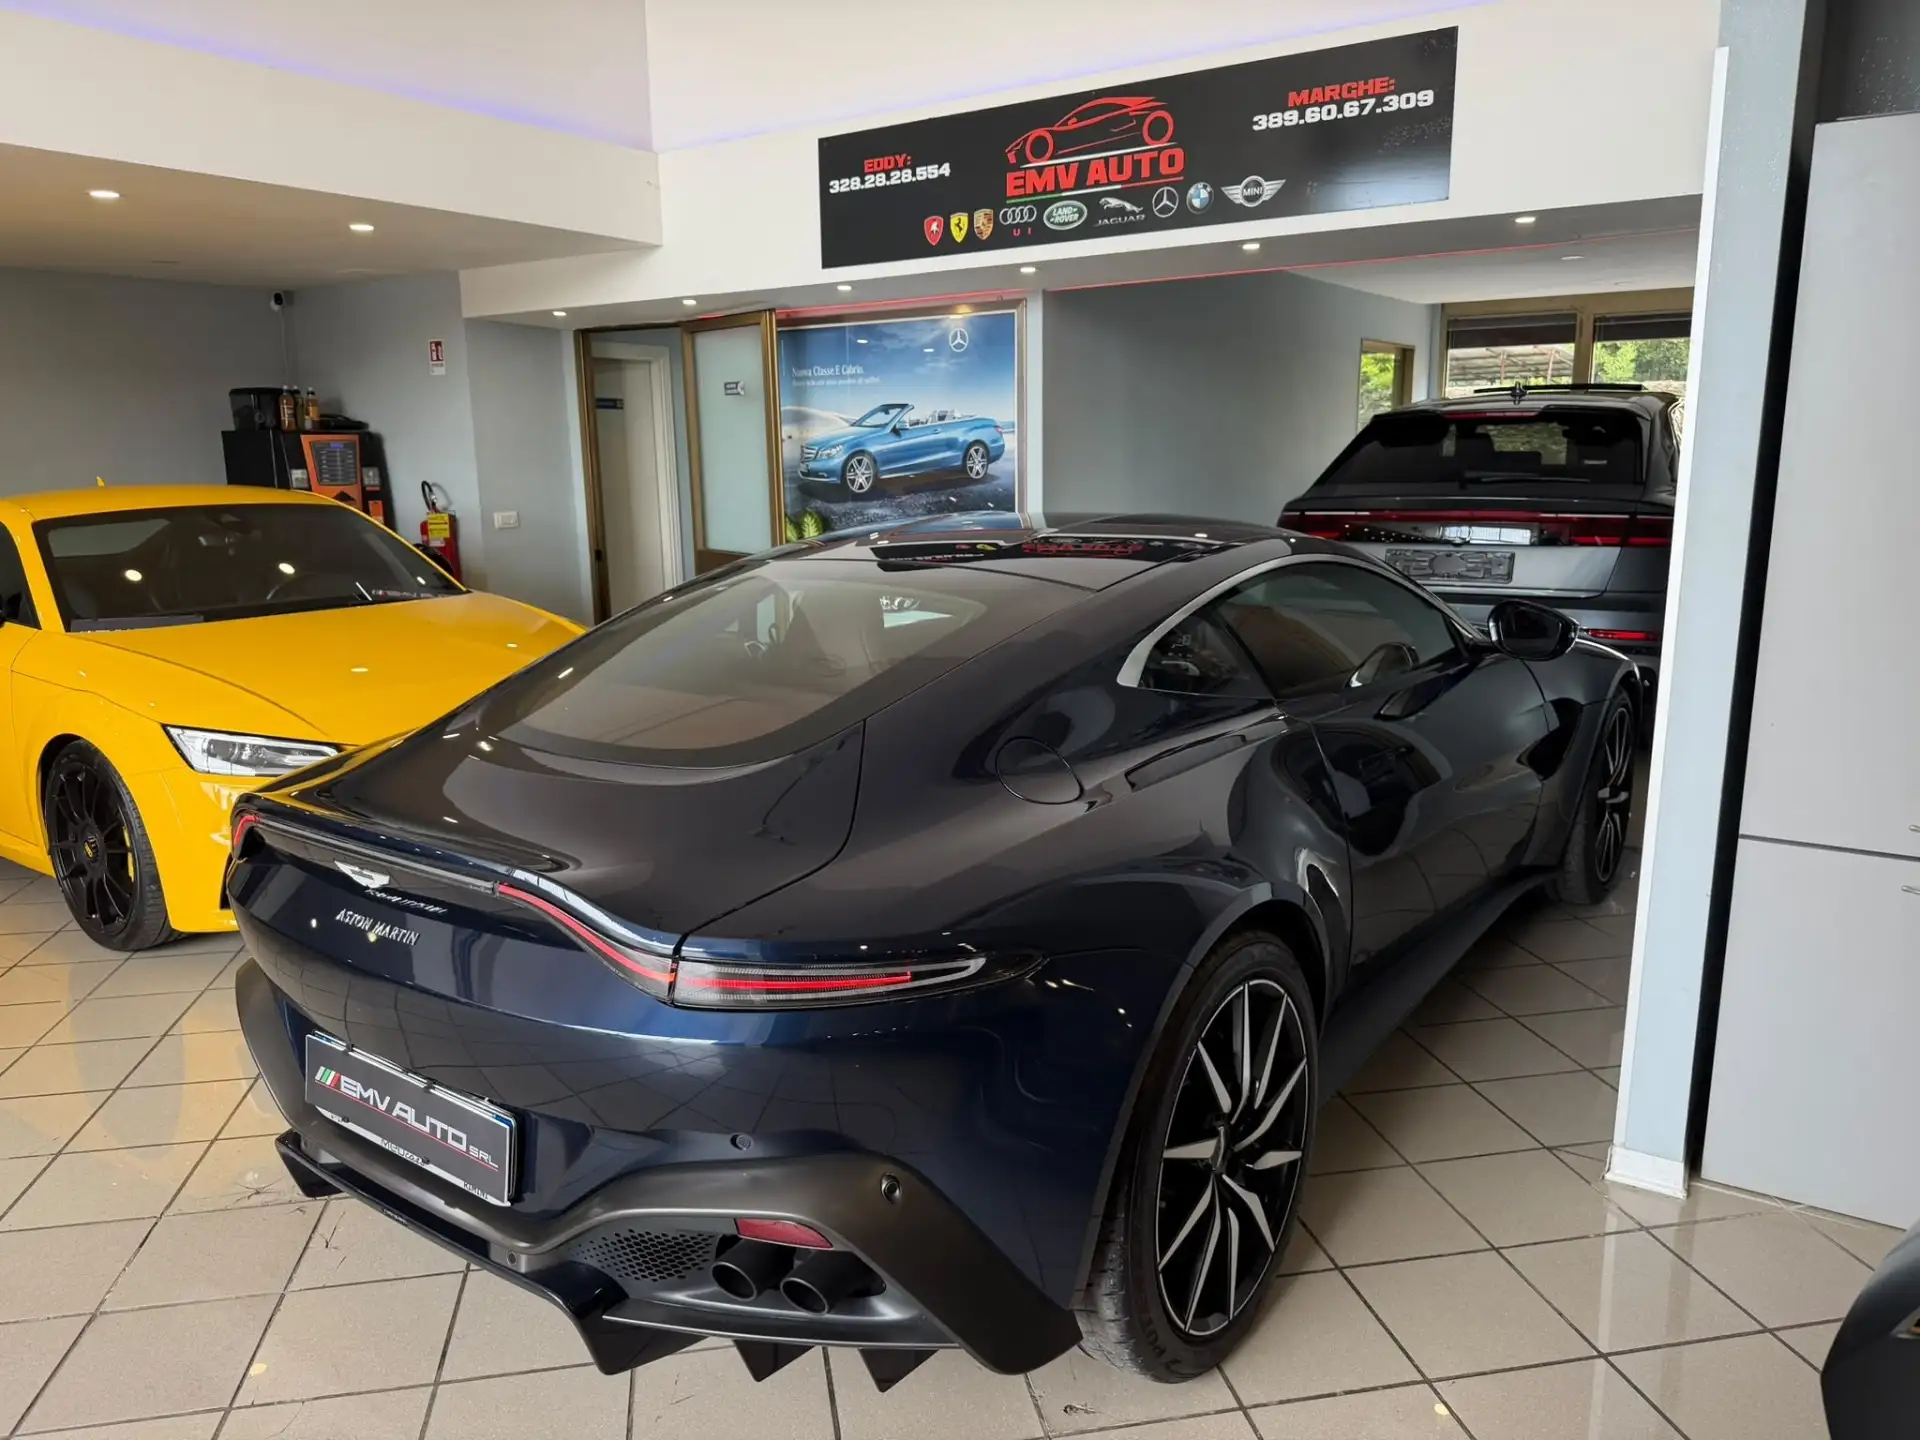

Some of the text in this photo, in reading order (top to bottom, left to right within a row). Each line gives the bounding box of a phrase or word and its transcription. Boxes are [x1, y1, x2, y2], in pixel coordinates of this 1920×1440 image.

[1288, 76, 1396, 107] MARCHE:
[1252, 89, 1435, 131] 389.60.67.309
[829, 162, 951, 194] 328.28.28.554
[864, 153, 911, 173] EDDY:
[1006, 147, 1184, 197] EMV AUTO
[1243, 187, 1263, 197] MINI
[1093, 214, 1145, 227] JAGUAR
[335, 908, 419, 946] ASTON MARTIN
[340, 1075, 390, 1110] EMV
[392, 1101, 467, 1151] AUTO
[469, 1145, 499, 1168] SRL
